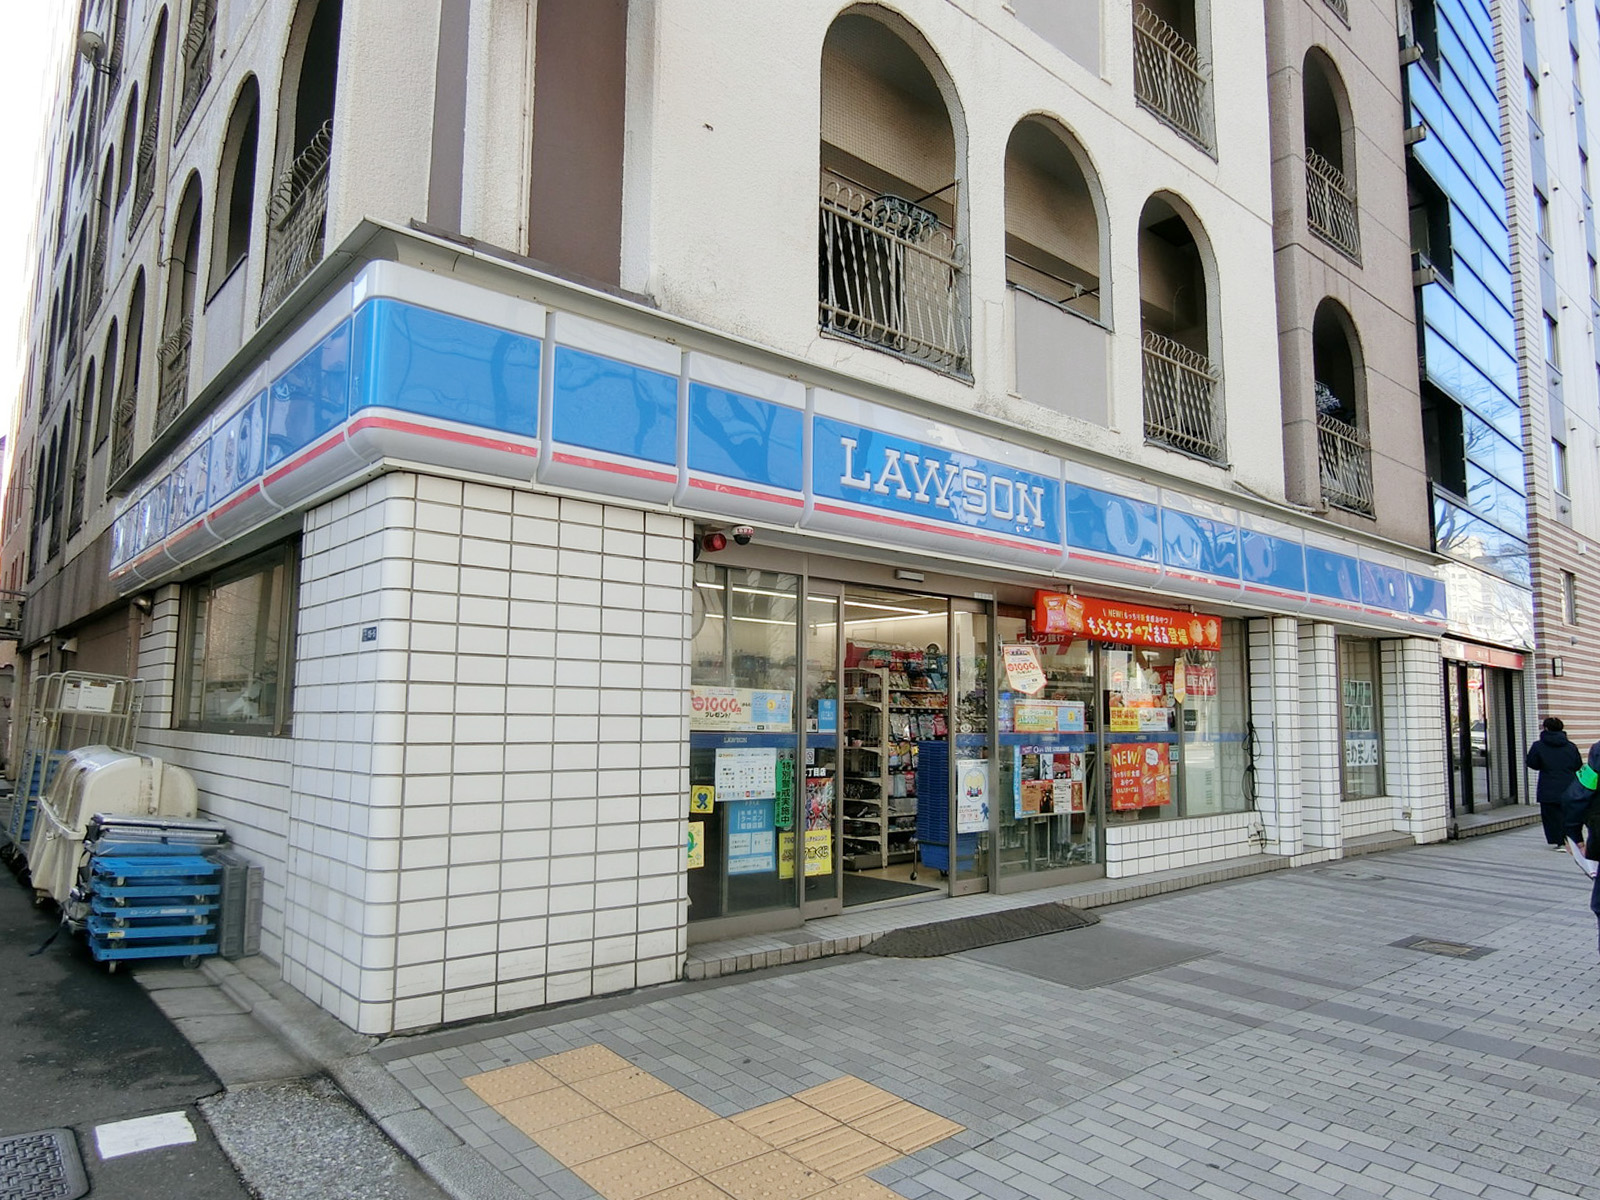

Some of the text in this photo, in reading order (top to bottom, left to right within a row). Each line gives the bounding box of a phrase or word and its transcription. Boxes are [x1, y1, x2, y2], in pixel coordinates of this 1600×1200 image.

[840, 436, 1046, 528] LAWSON
[1019, 634, 1065, 645] ロソン銀行
[1113, 750, 1141, 768] NEW!
[804, 766, 827, 778] 丁目店
[781, 761, 792, 824] 特別警戒実施中
